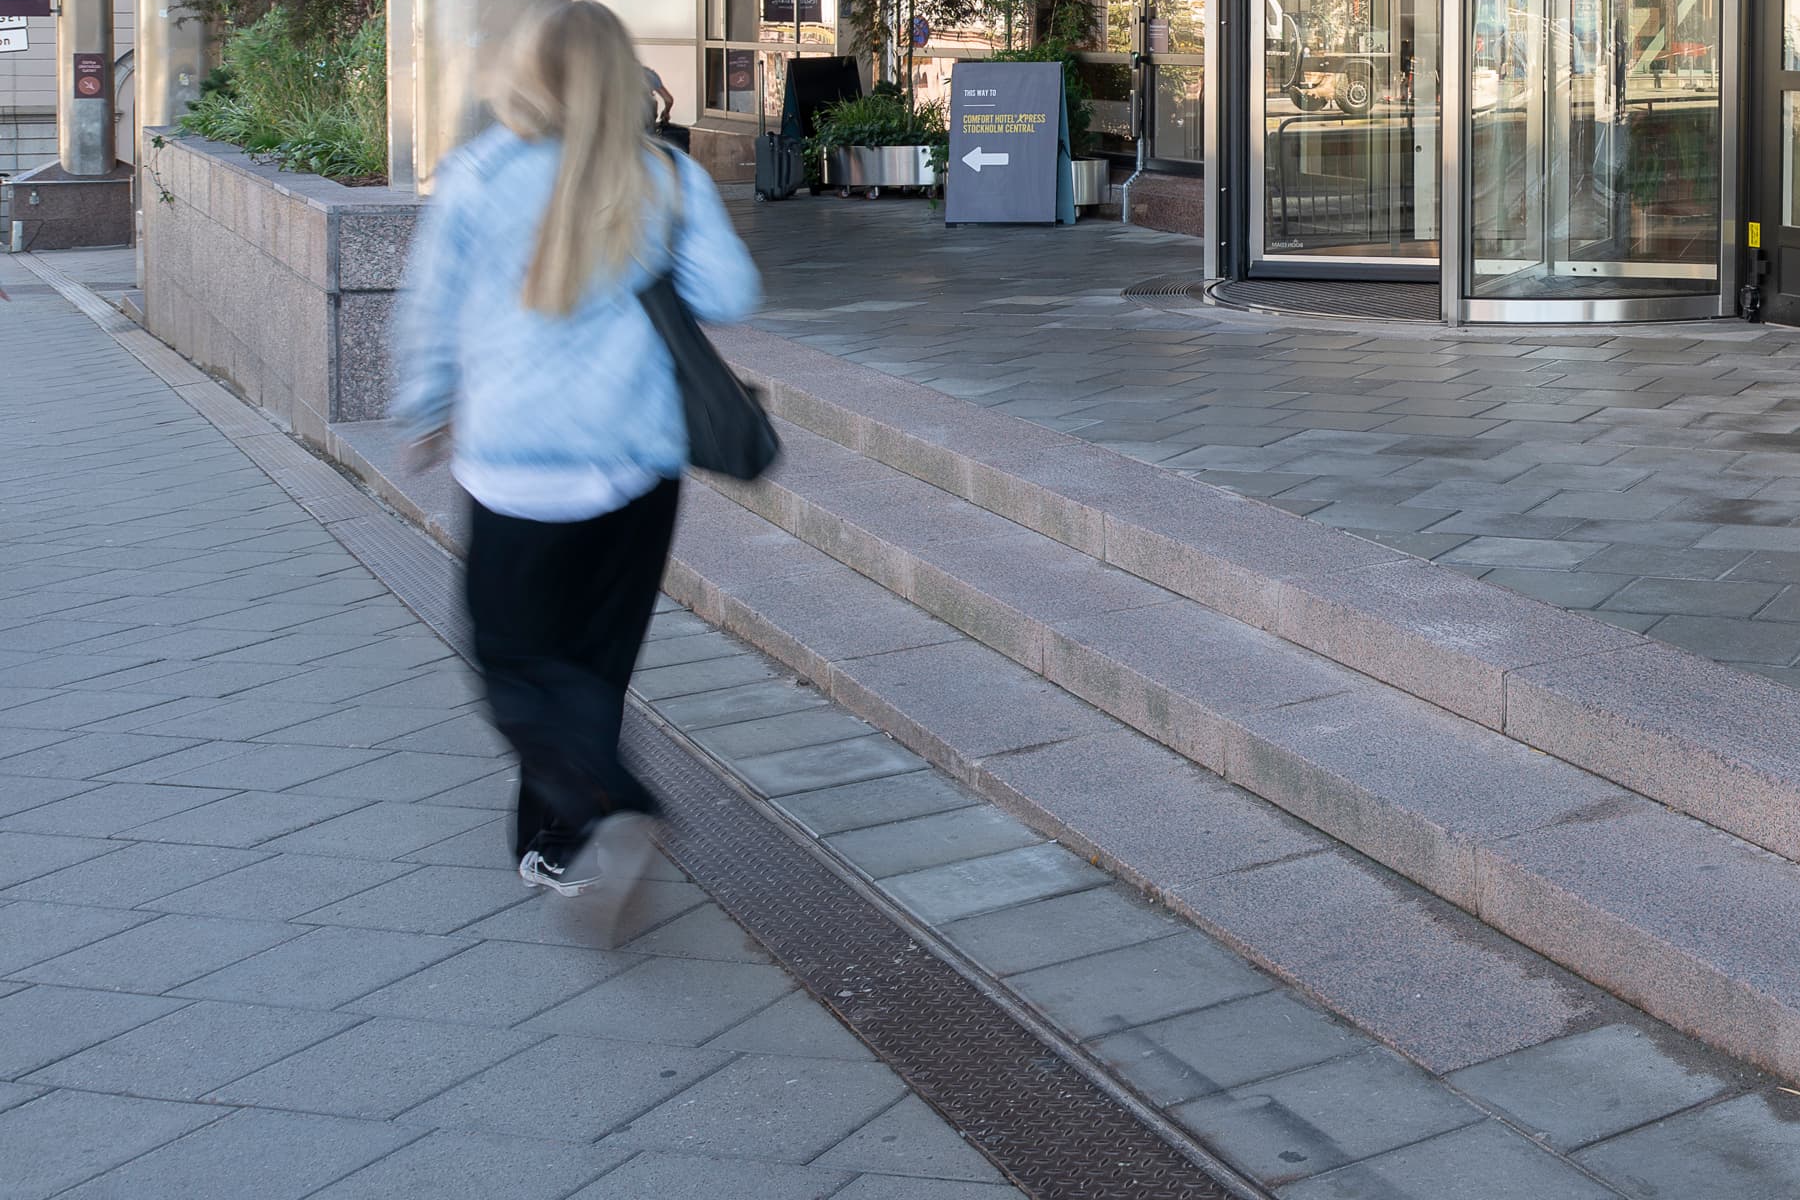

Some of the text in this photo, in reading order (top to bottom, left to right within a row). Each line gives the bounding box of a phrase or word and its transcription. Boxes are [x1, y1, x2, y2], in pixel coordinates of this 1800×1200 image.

[964, 89, 997, 97] THIS WAY TO
[963, 114, 994, 124] COMFORT
[1016, 113, 1046, 123] XPRESS
[963, 123, 1036, 134] STOCKHOLM CENTRAL
